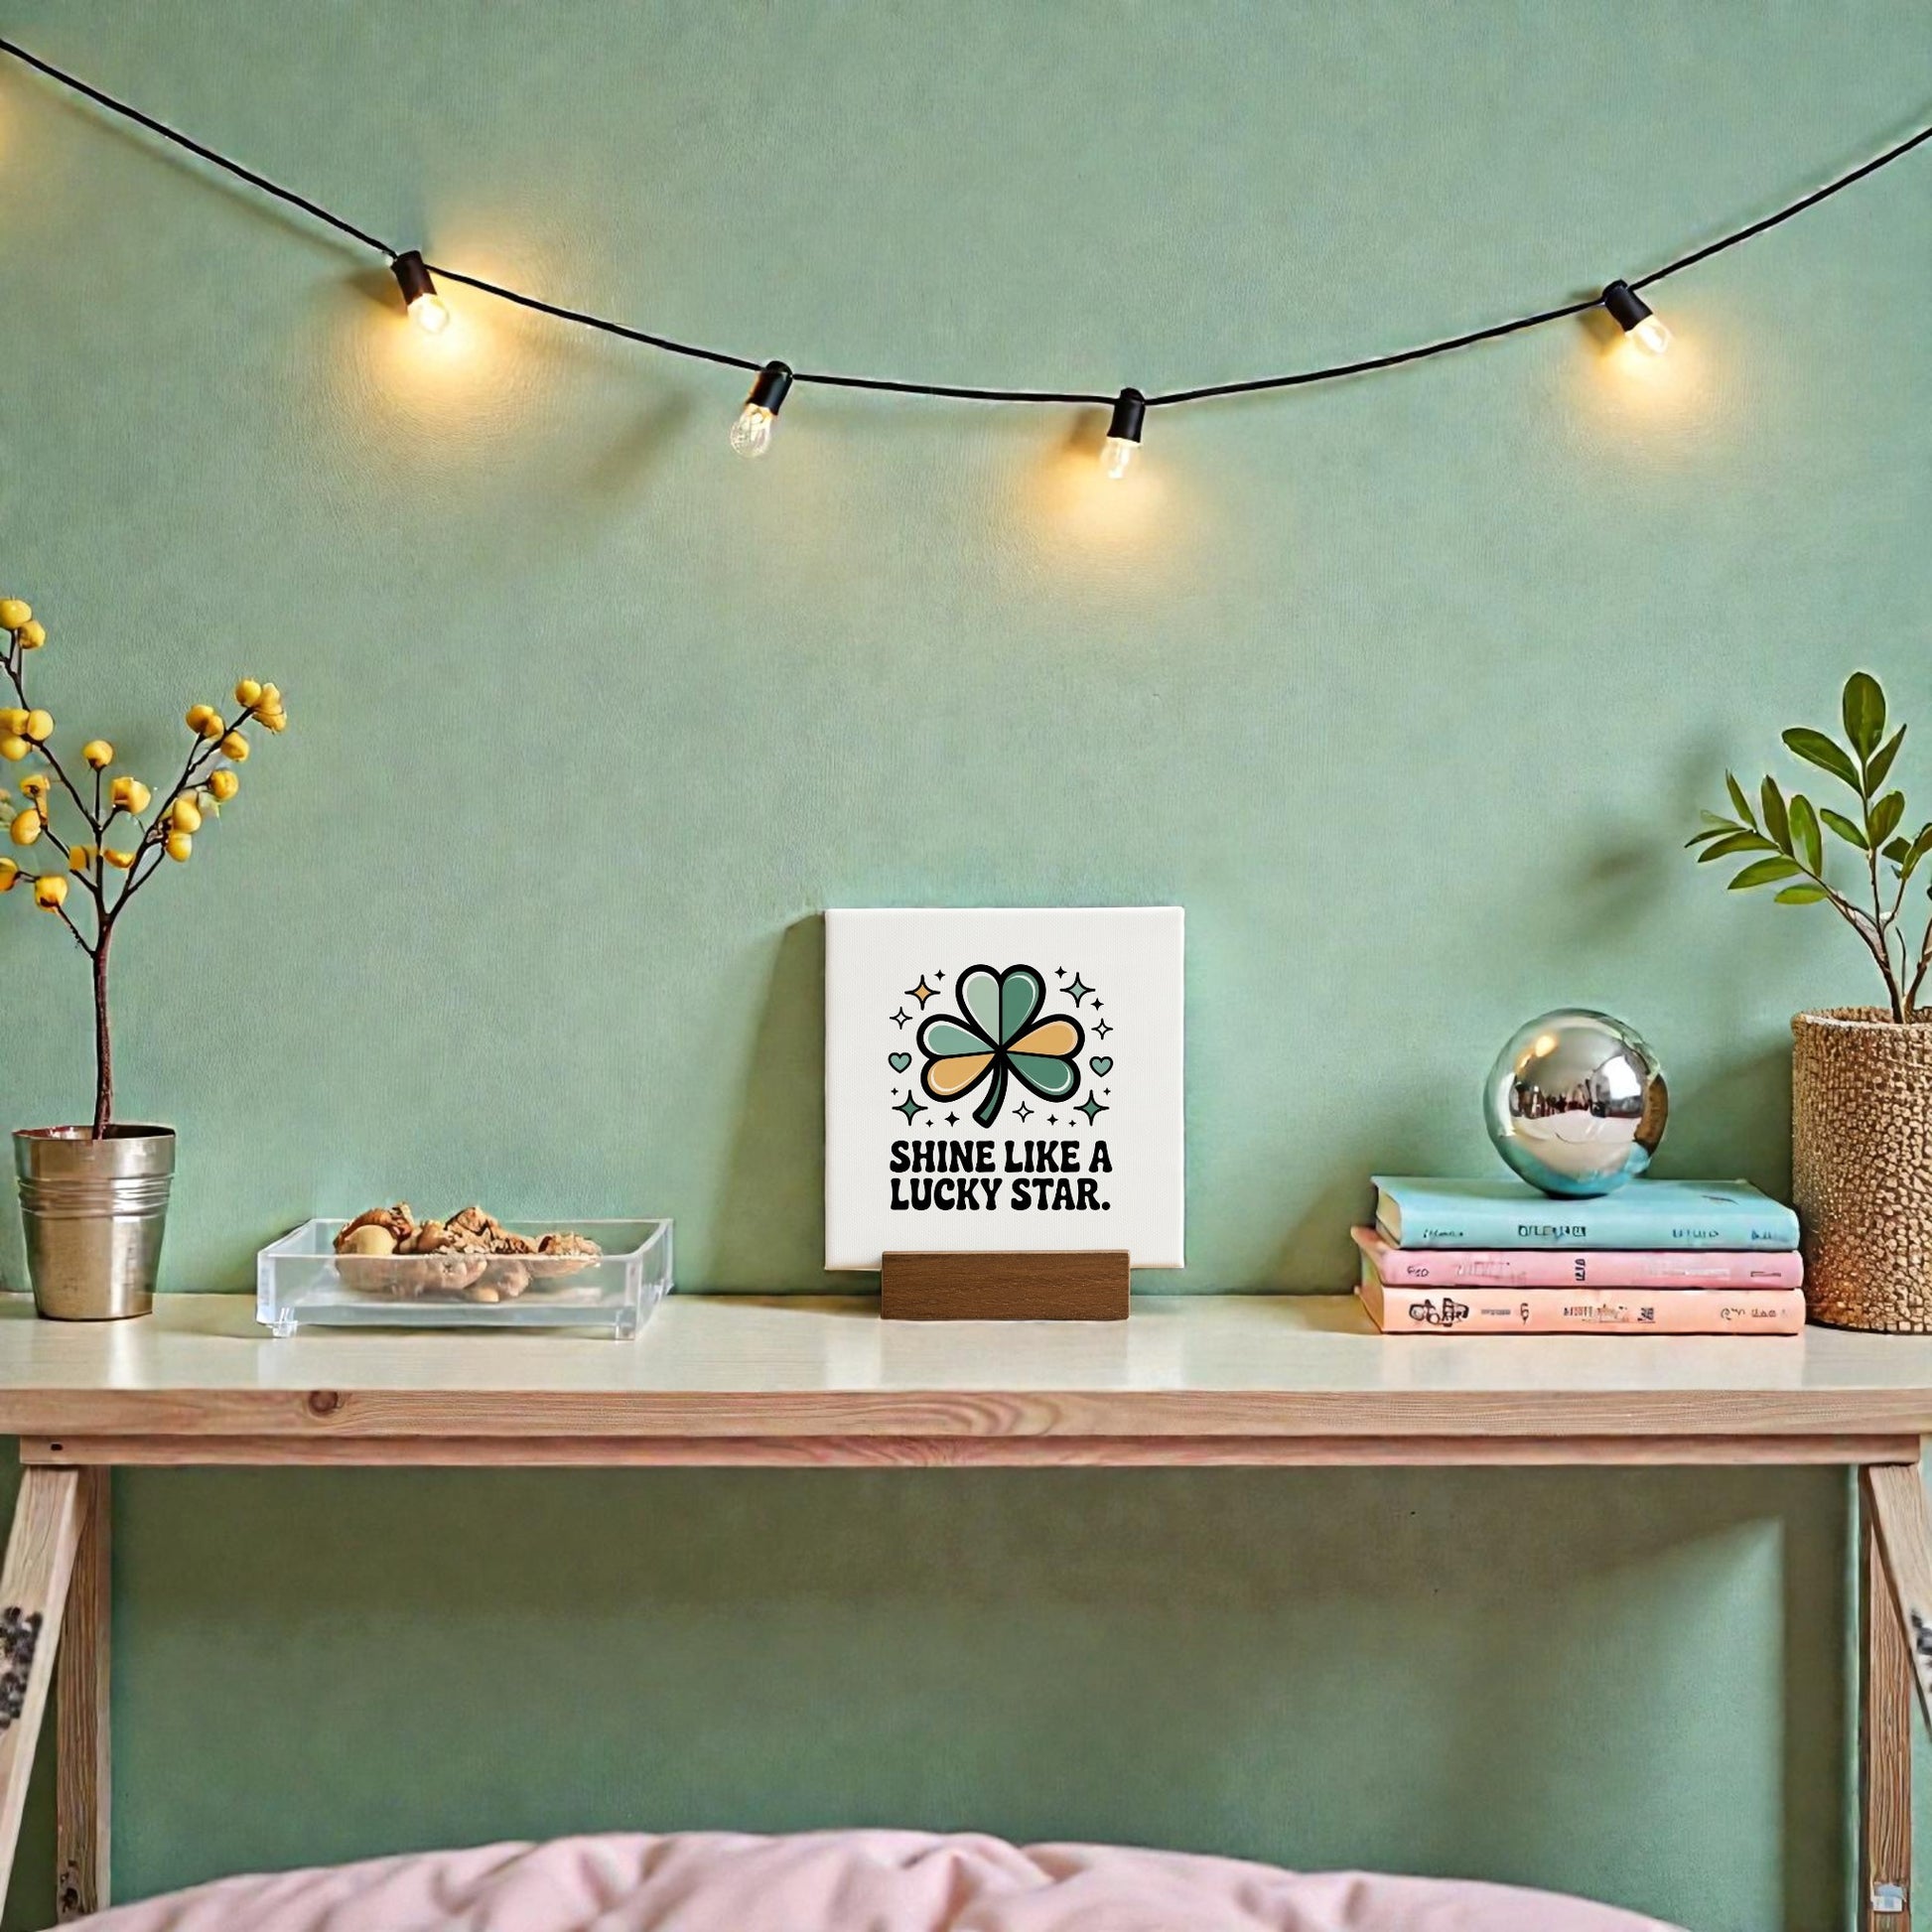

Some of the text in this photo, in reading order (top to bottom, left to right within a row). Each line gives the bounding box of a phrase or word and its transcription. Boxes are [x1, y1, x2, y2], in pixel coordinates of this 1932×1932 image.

[890, 1140, 1113, 1173] SHINE LIKE A
[890, 1177, 1111, 1210] LUCKY STAR.
